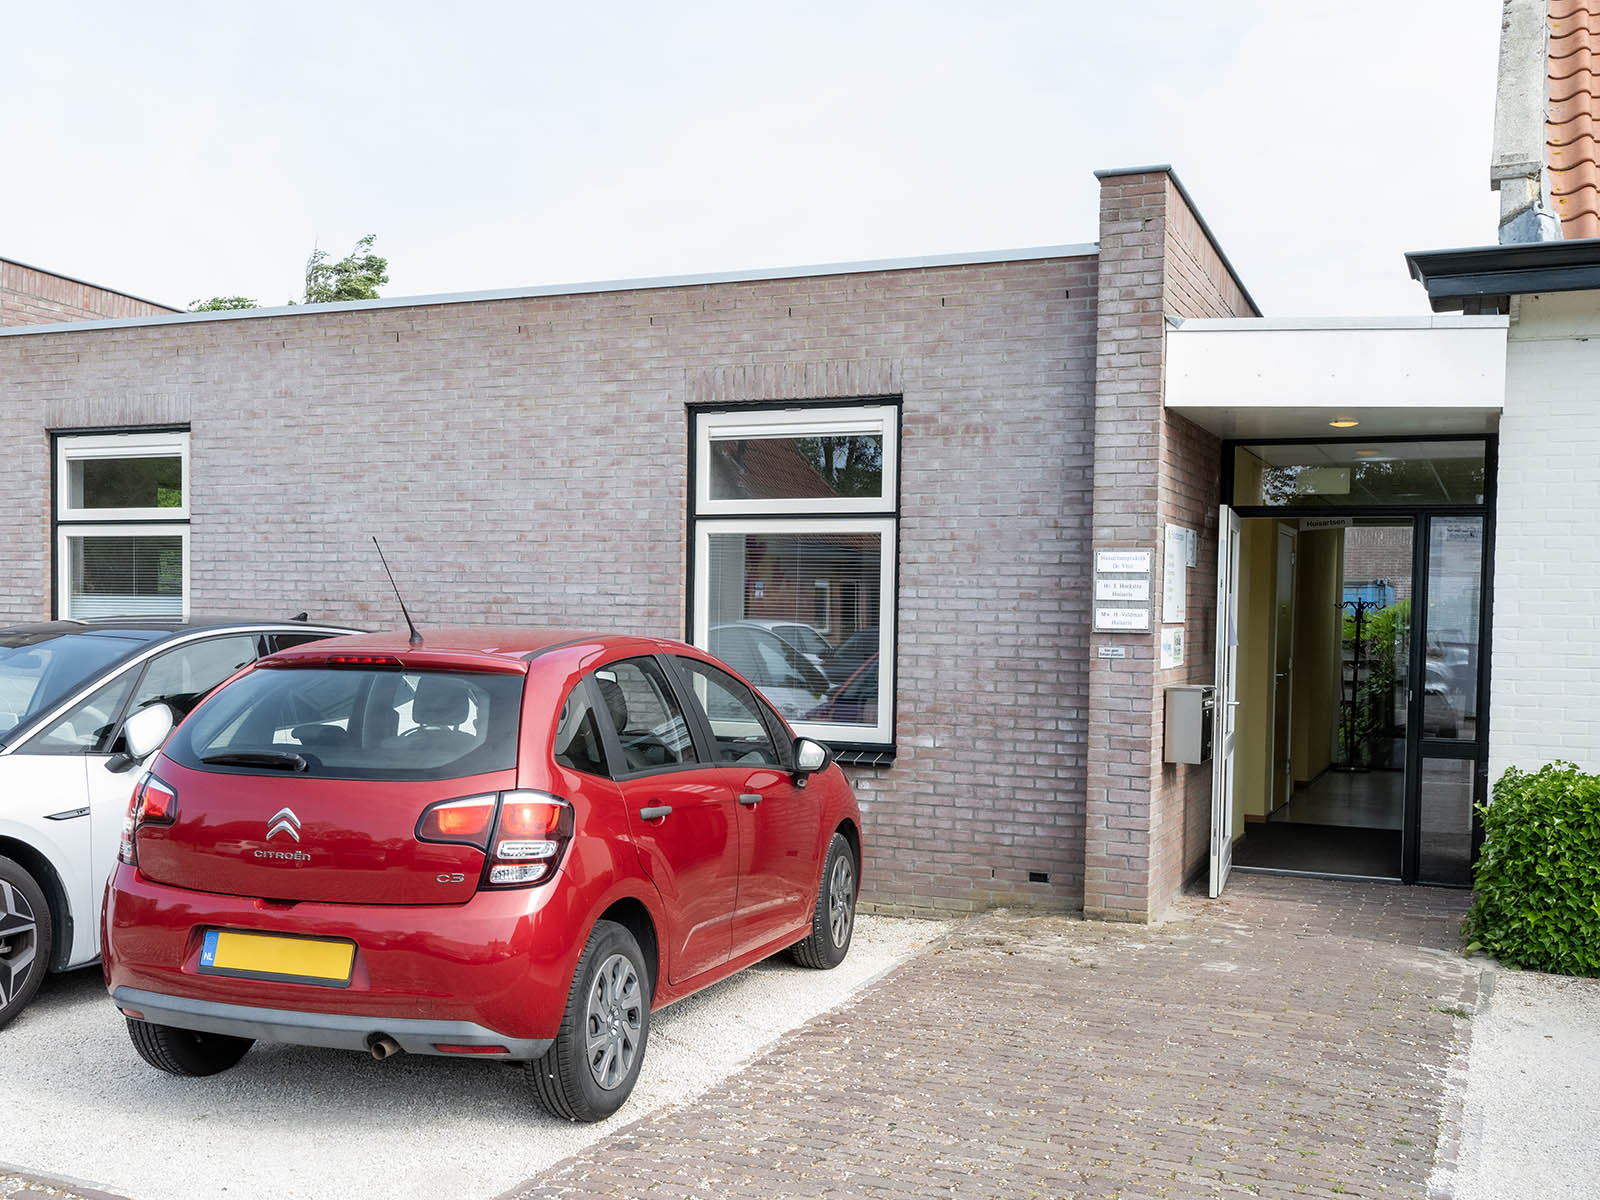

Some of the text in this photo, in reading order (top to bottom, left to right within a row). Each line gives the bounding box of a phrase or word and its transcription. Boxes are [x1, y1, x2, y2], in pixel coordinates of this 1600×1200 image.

[1306, 518, 1346, 527] Huisartsen
[436, 872, 465, 883] C3
[203, 951, 213, 961] NL
